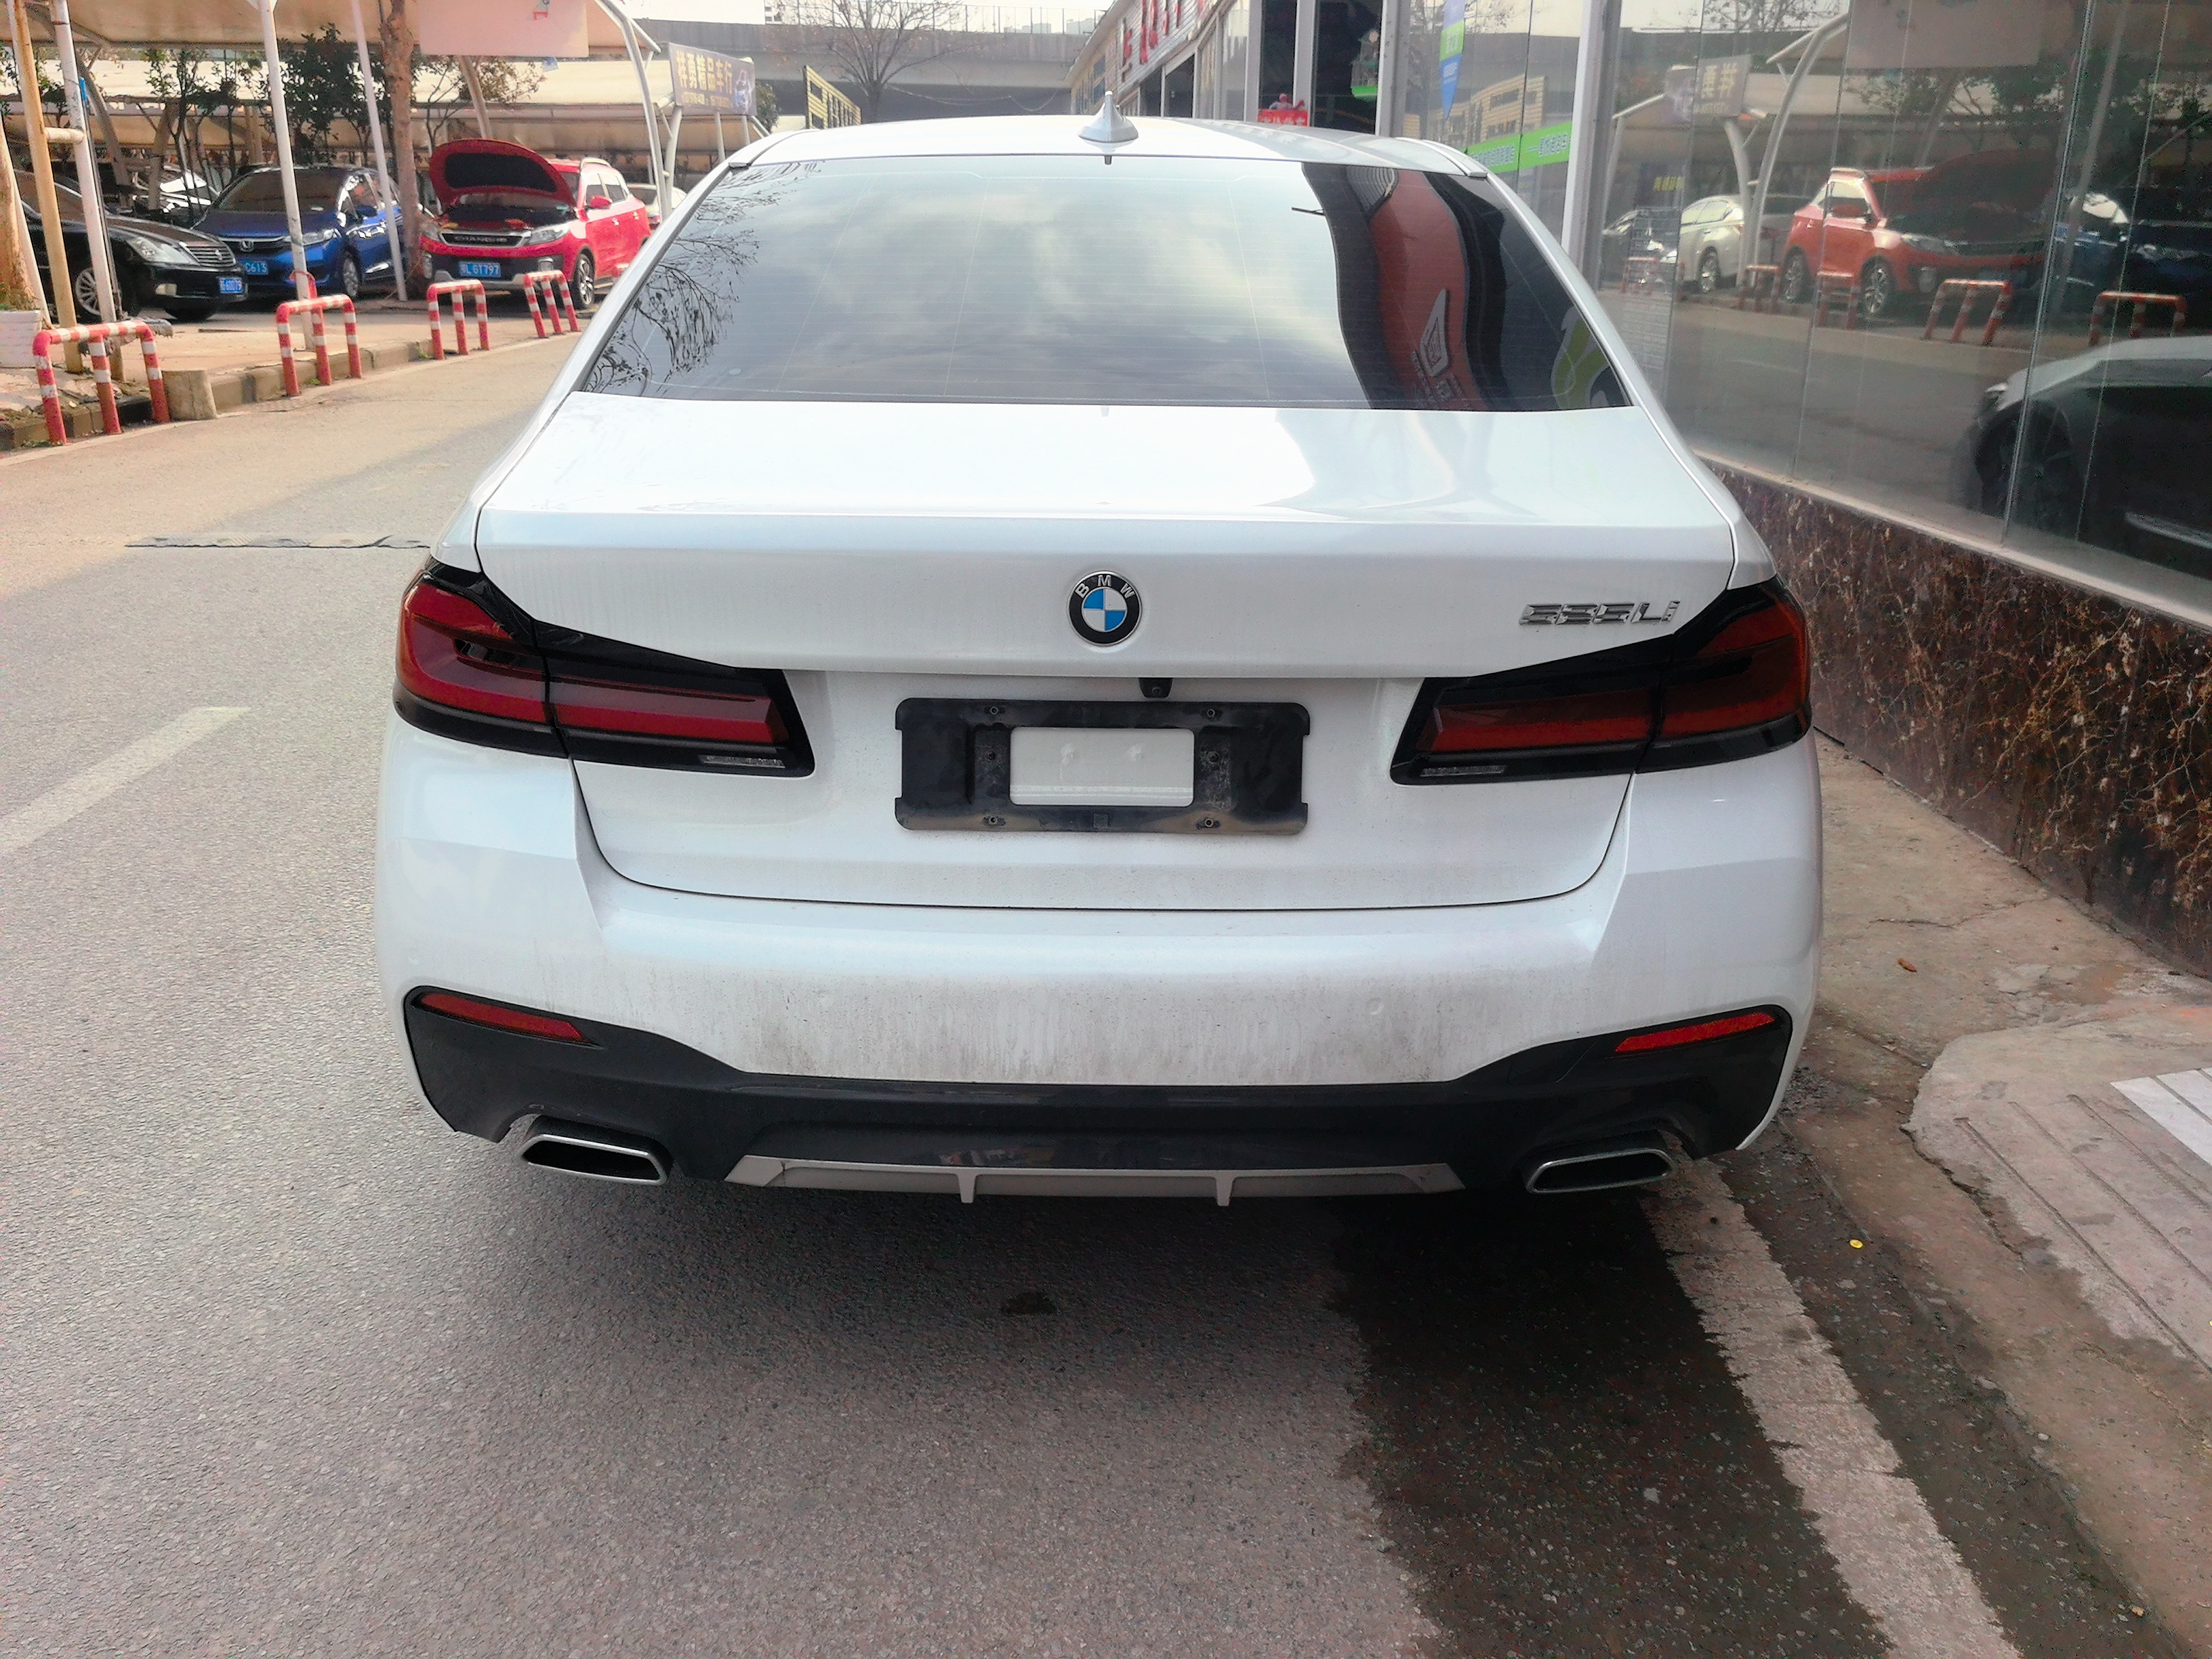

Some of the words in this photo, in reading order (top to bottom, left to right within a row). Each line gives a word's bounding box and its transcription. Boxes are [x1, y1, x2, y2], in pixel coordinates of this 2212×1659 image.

[245, 262, 268, 273] C613
[1075, 574, 1136, 599] BMW
[1519, 600, 1681, 625] 525Li
